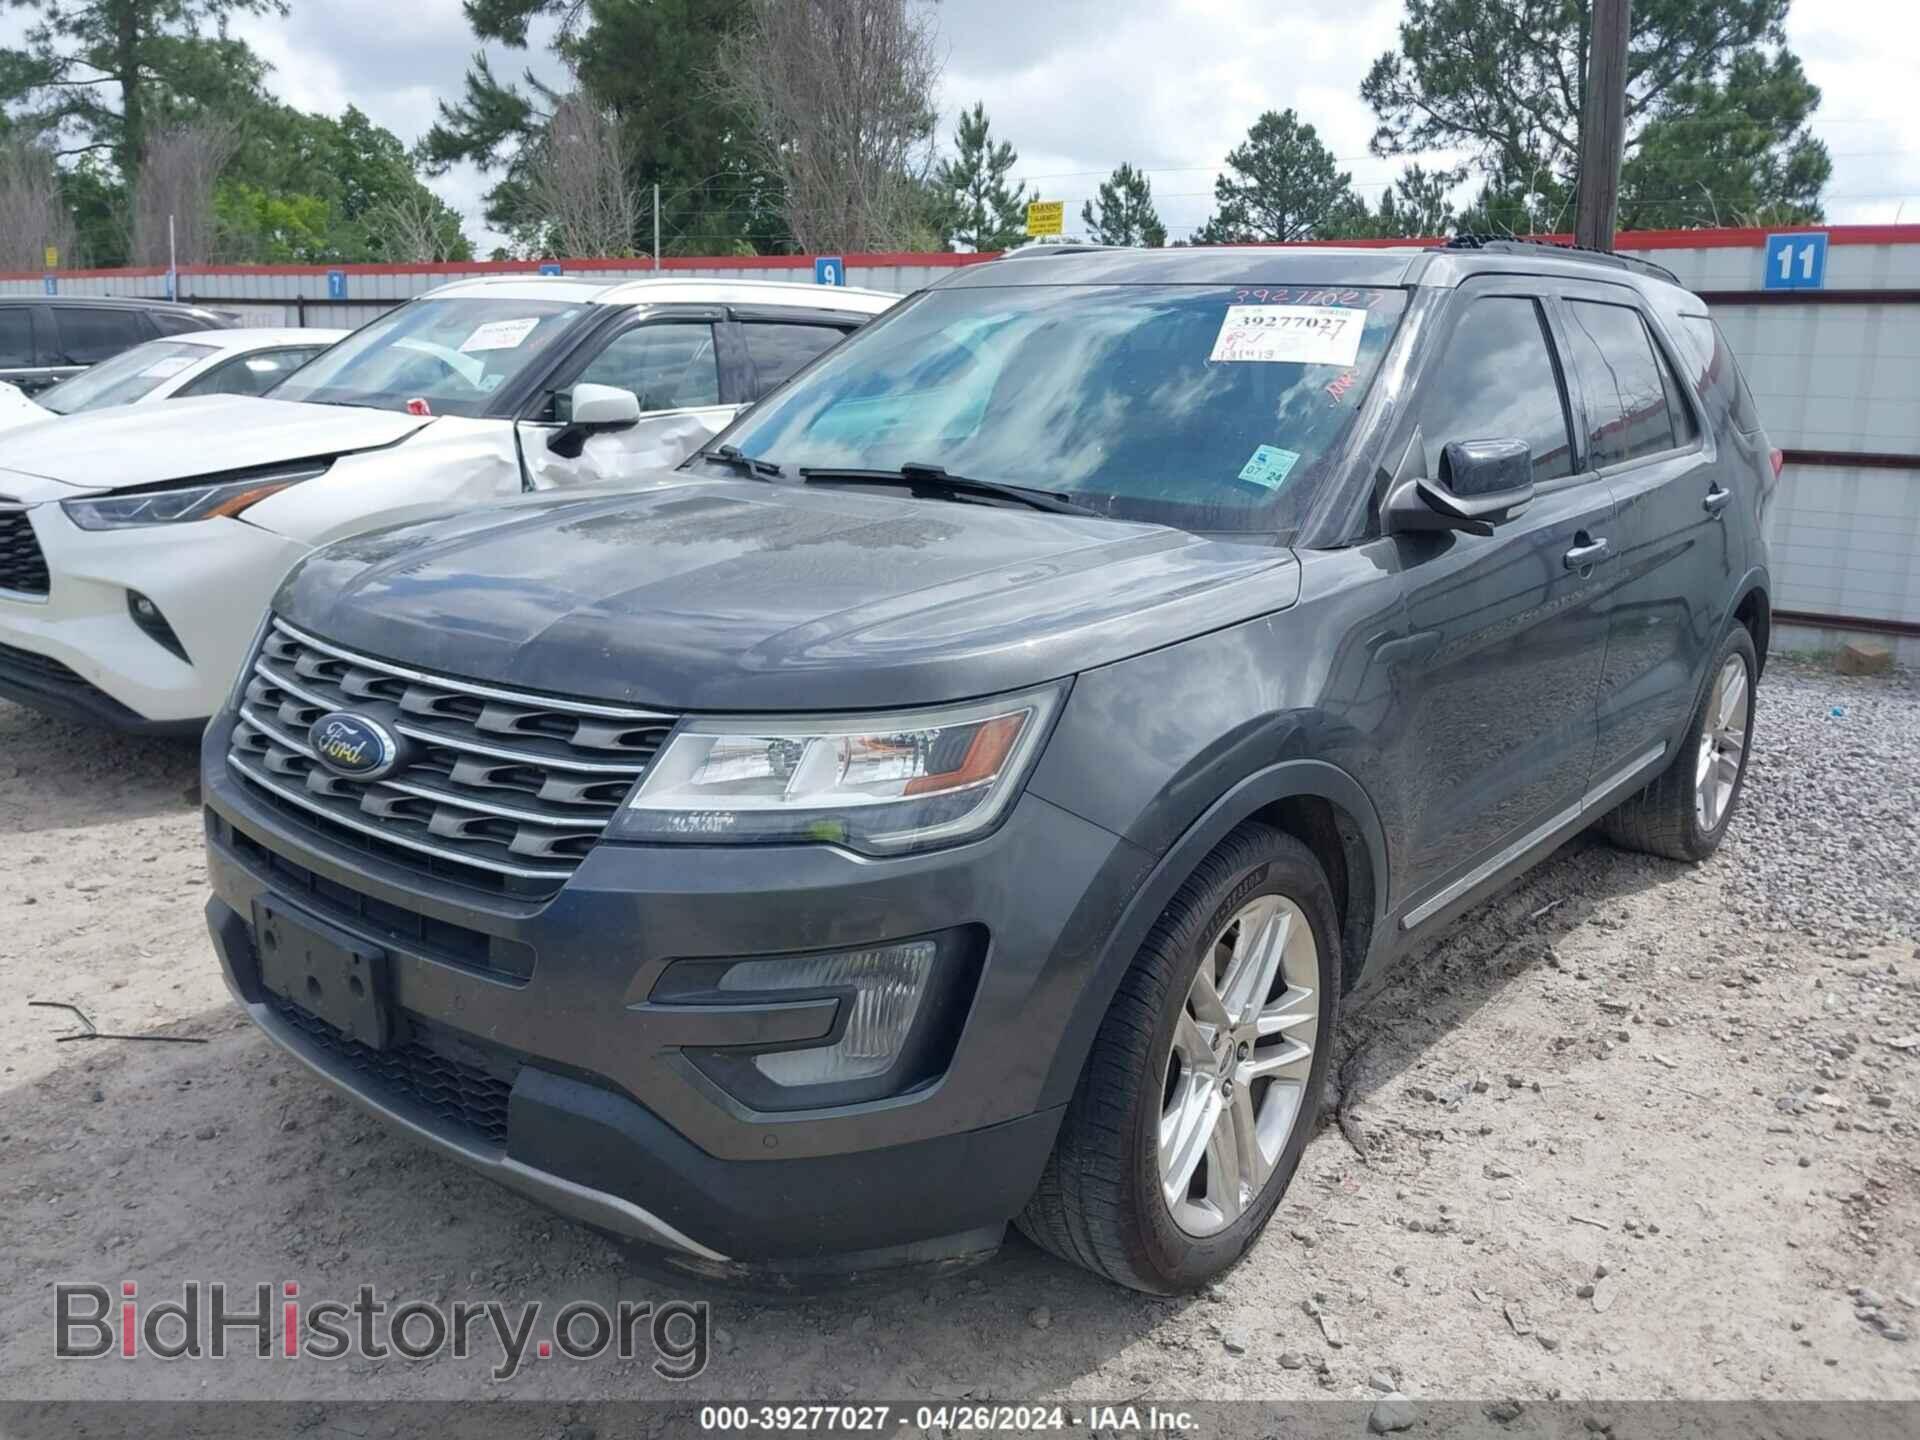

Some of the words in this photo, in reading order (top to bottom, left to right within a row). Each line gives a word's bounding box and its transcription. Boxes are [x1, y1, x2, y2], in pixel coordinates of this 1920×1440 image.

[1776, 243, 1815, 280] 11
[332, 275, 340, 295] 7
[823, 264, 836, 287] 9
[1241, 315, 1348, 332] 39277027
[318, 721, 368, 764] Ford
